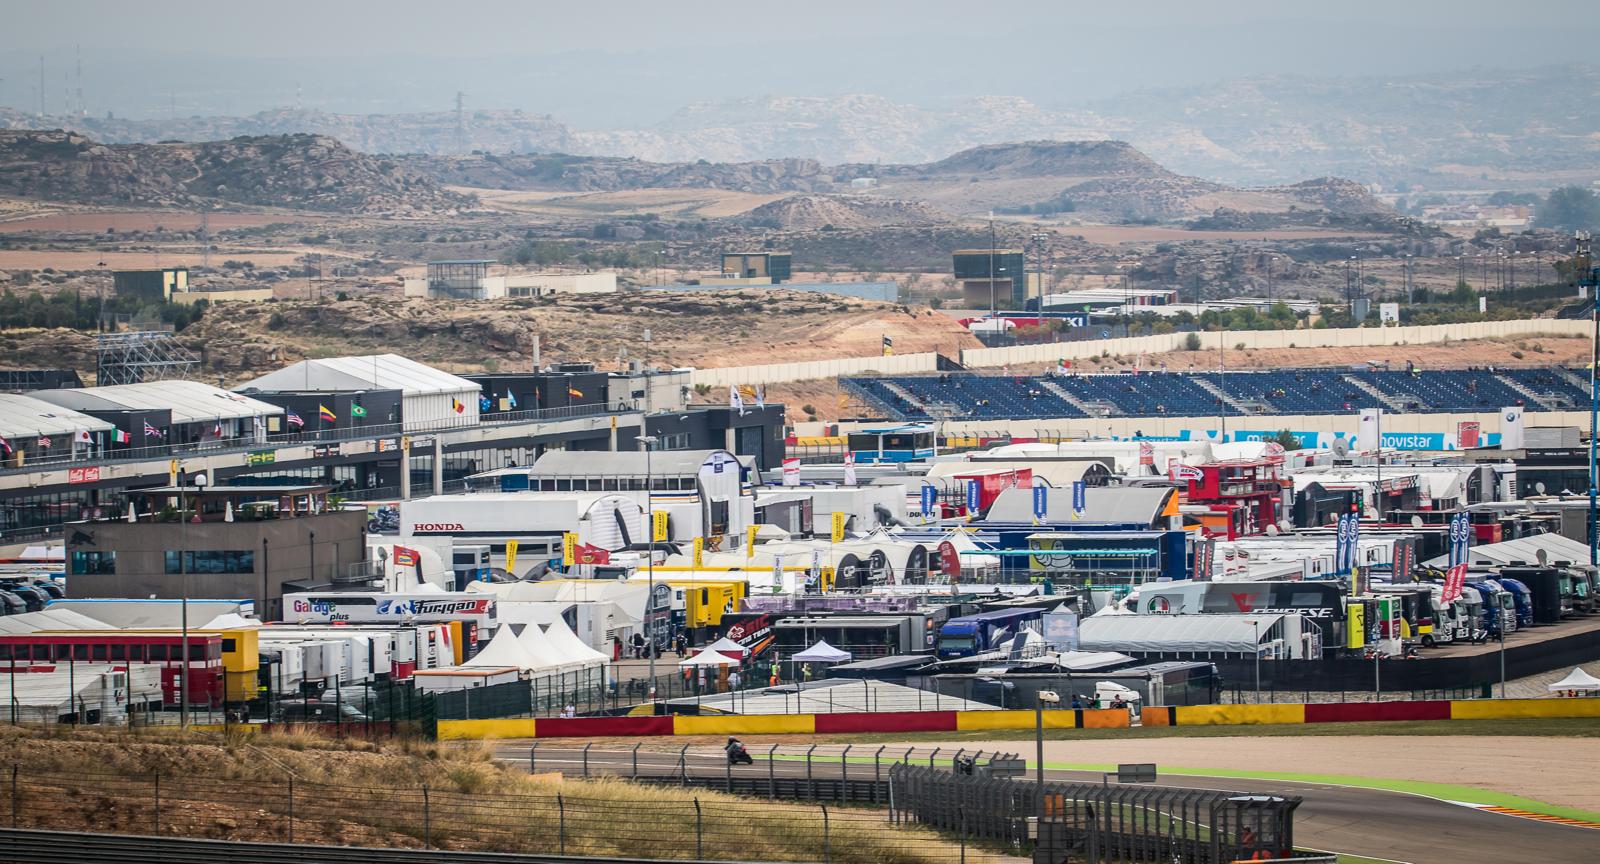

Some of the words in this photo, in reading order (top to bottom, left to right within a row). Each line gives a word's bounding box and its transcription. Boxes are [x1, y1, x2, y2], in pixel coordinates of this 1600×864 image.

[414, 523, 464, 531] HONDA
[294, 600, 336, 616] Garage
[329, 612, 350, 621] plus
